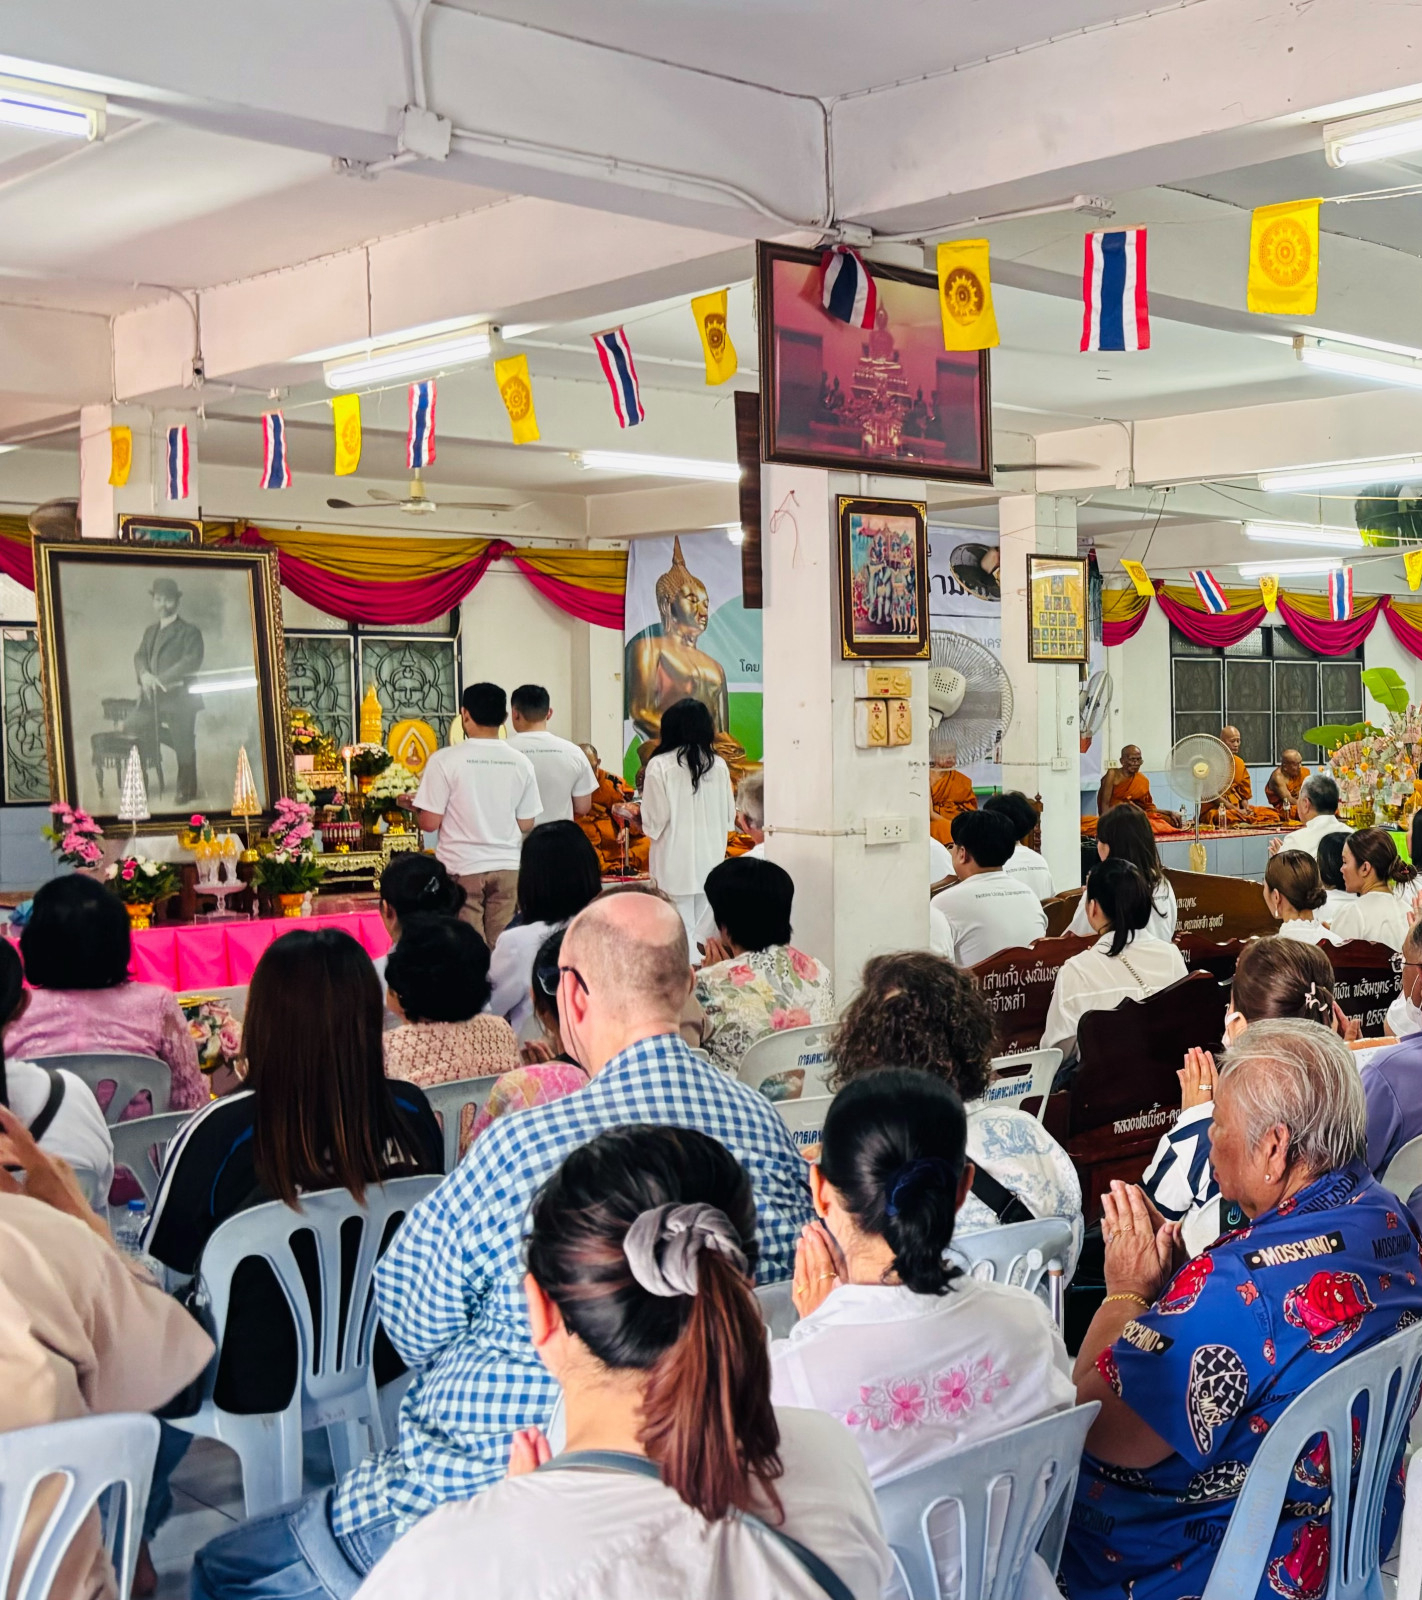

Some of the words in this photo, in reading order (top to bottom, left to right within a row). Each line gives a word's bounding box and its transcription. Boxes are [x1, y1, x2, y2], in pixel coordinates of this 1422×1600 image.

[738, 658, 761, 673] โดย
[1258, 1234, 1333, 1267] MOSCHINO
[1371, 1233, 1412, 1260] MOSCHINO
